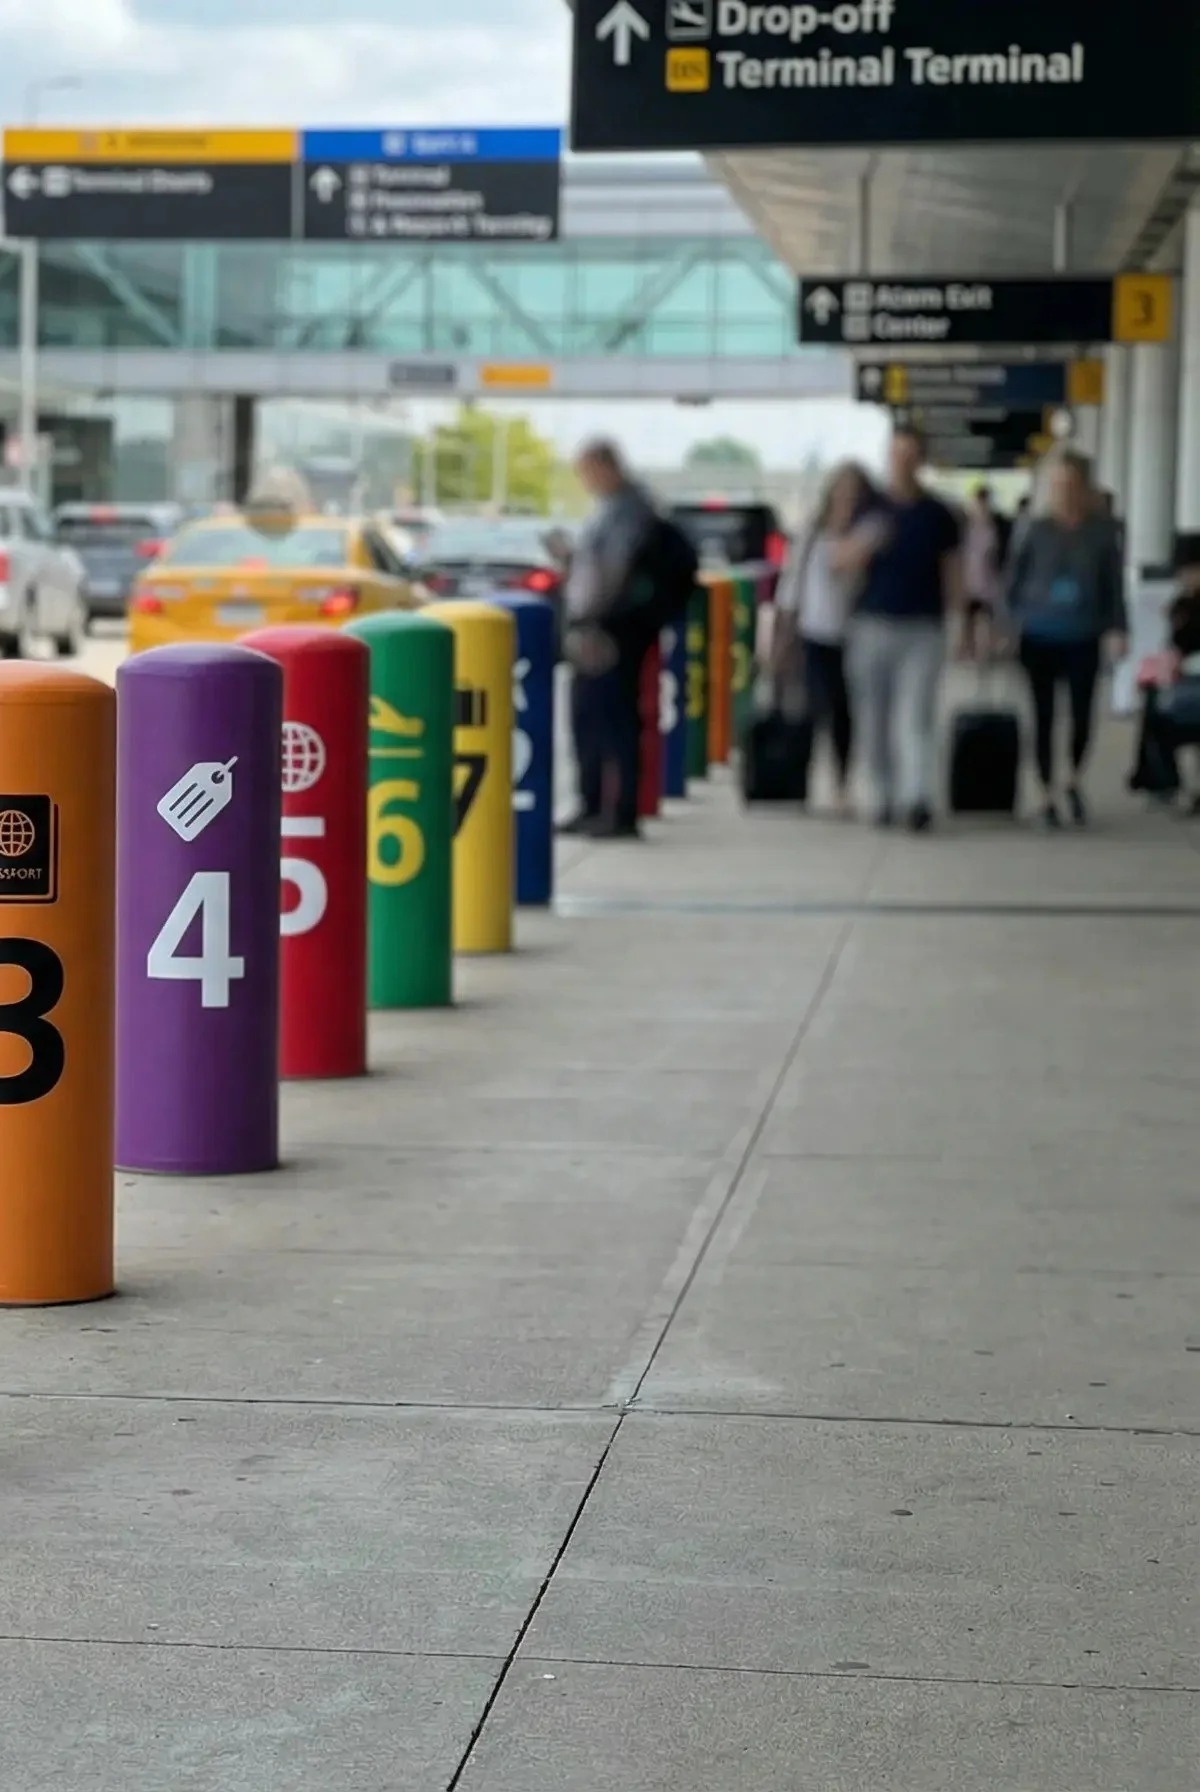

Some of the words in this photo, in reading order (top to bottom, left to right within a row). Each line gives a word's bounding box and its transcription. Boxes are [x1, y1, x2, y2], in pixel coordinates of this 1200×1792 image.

[717, 0, 895, 43] Drop-off
[716, 47, 895, 89] Terminal
[904, 43, 1084, 85] Terminal
[367, 779, 425, 886] 6
[146, 871, 245, 1008] 4
